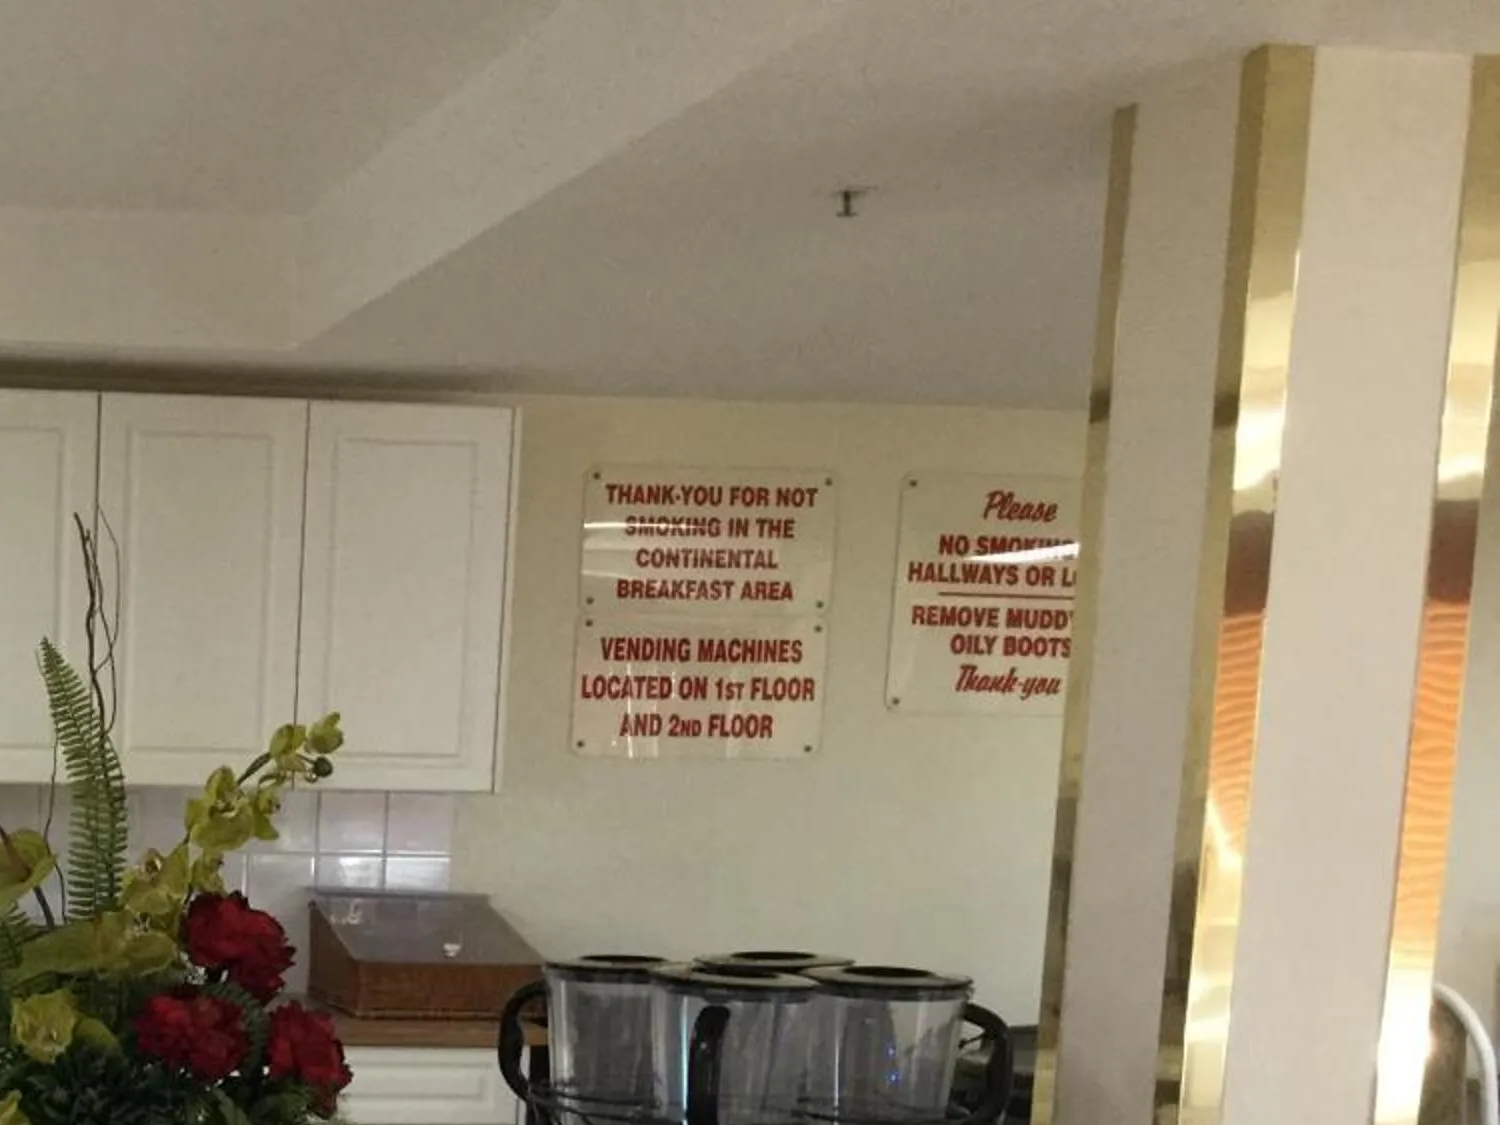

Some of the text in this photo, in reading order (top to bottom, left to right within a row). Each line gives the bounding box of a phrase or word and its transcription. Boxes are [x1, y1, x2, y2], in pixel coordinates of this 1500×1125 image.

[729, 487, 770, 507] FOR
[775, 487, 818, 508] NOT
[982, 490, 1058, 522] Please
[624, 515, 796, 538] SMOKING IN THE
[938, 534, 969, 556] NO
[635, 547, 778, 569] CONTINENTAL
[907, 560, 1078, 588] HALLWAYS OR L
[616, 578, 793, 601] BREAKFAST AREA
[911, 605, 1074, 630] REMOVE MUDD
[601, 637, 803, 663] VENDING MACHINES
[950, 633, 1072, 658] OILY BOOTS
[581, 674, 673, 699] LOCATED
[679, 676, 708, 699] ON
[750, 677, 815, 701] FLOOR
[955, 664, 1061, 700] Thank-you
[619, 713, 661, 736] AND
[707, 714, 773, 738] FLOOR
